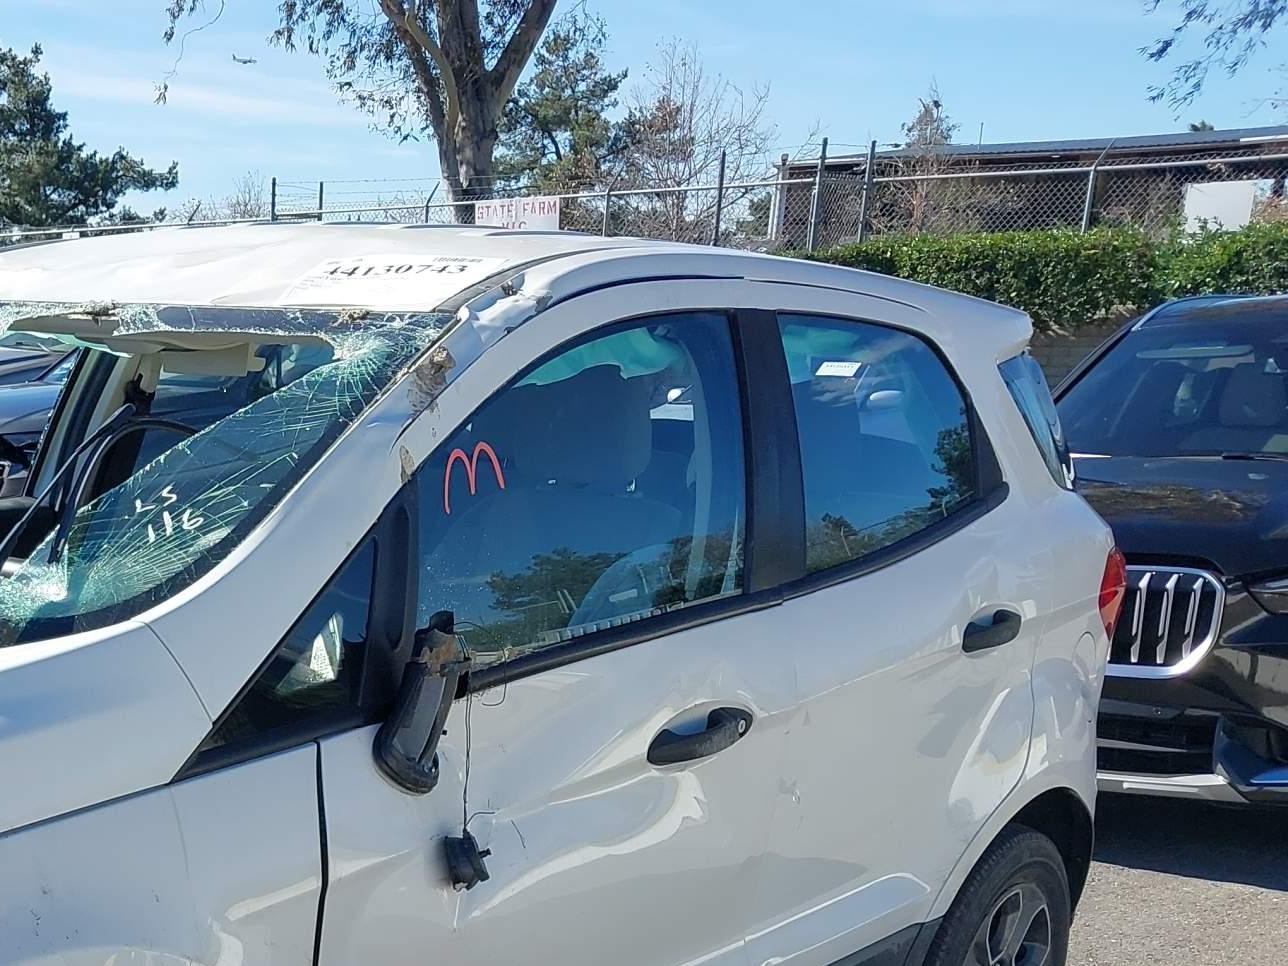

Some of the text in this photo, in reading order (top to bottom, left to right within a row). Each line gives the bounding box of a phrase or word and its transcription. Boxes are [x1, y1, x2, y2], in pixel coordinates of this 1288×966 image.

[477, 200, 557, 219] STATE FARM
[323, 264, 469, 277] 44130743
